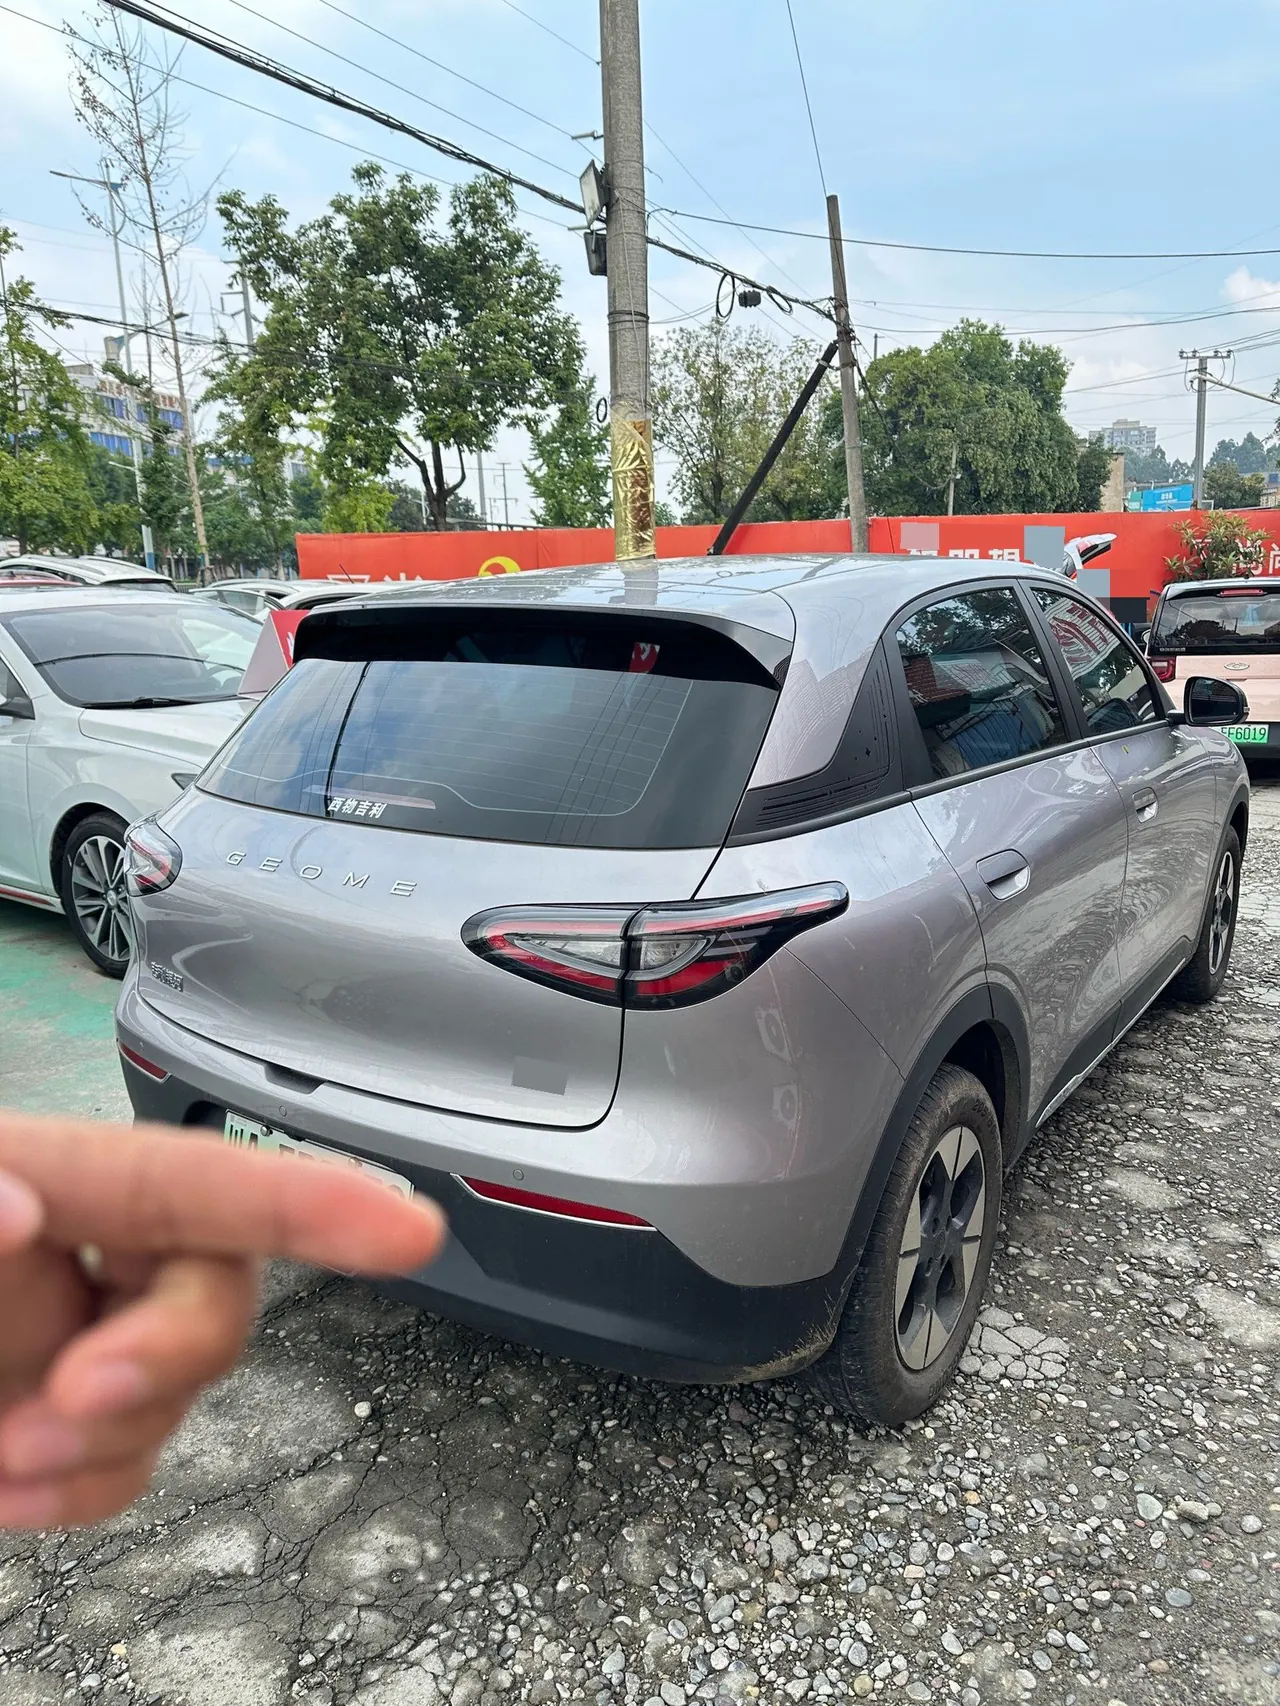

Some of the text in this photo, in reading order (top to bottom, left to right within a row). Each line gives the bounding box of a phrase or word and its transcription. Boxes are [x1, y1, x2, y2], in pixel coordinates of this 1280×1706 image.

[327, 796, 388, 819] 西物吉利
[226, 851, 417, 897] GEOME
